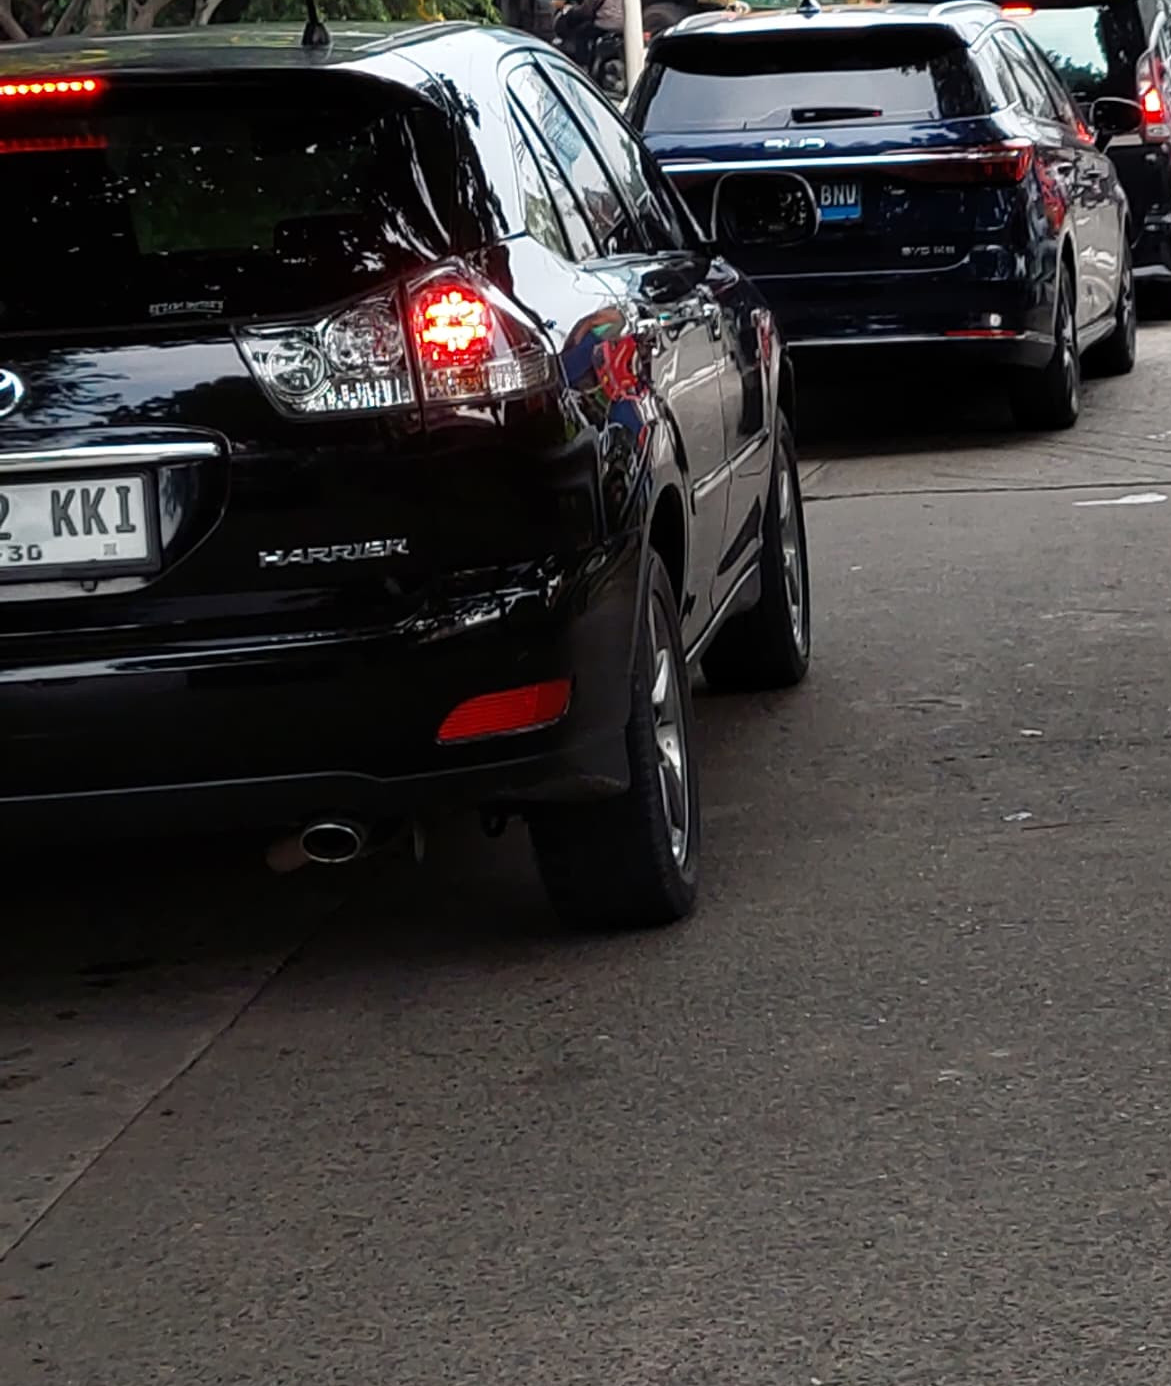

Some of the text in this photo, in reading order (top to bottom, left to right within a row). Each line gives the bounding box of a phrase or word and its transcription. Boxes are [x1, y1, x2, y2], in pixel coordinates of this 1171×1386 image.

[820, 184, 857, 206] BNV
[51, 485, 137, 538] KKI
[258, 537, 410, 569] HARRIER
